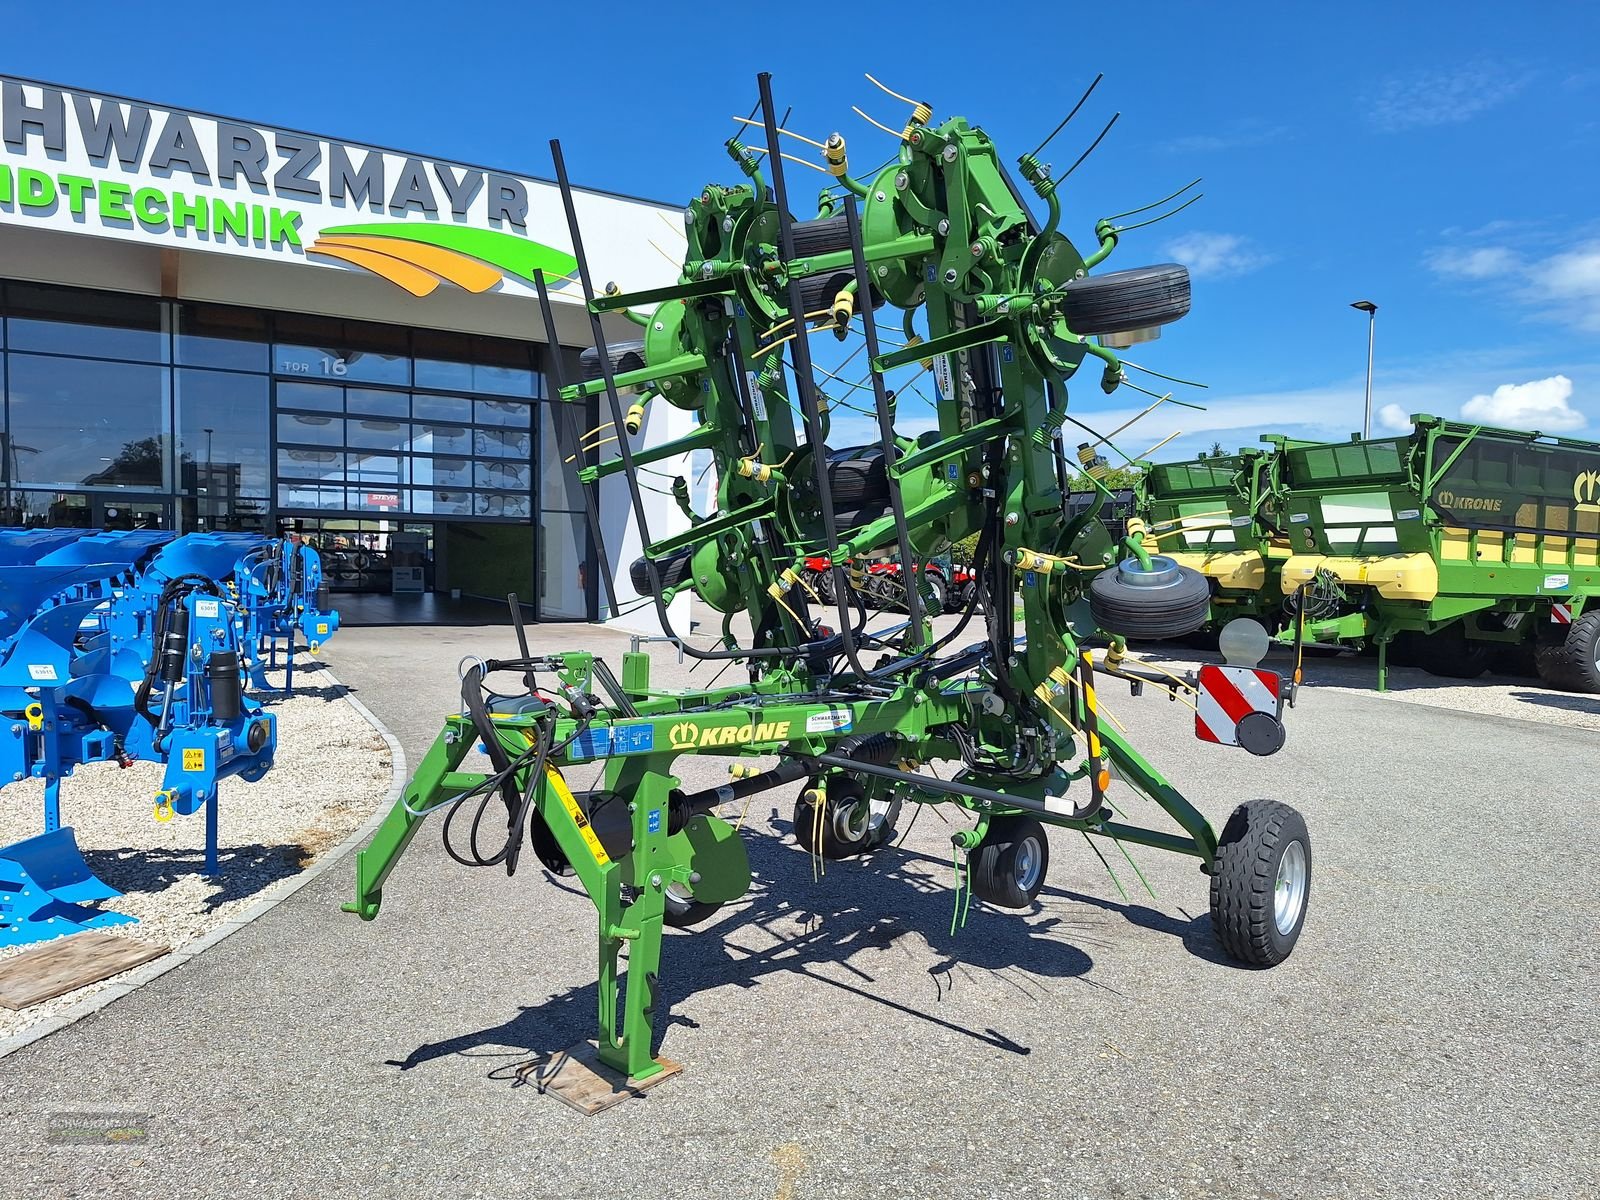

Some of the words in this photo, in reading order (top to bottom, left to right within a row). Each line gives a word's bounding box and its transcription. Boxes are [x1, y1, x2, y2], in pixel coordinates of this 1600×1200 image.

[1, 80, 529, 228] HWARZMAYR
[283, 361, 310, 371] TOR
[321, 357, 348, 376] 16
[1454, 496, 1503, 512] KRONE
[811, 714, 847, 722] SCHWARZMAYR
[699, 721, 791, 747] KRONE
